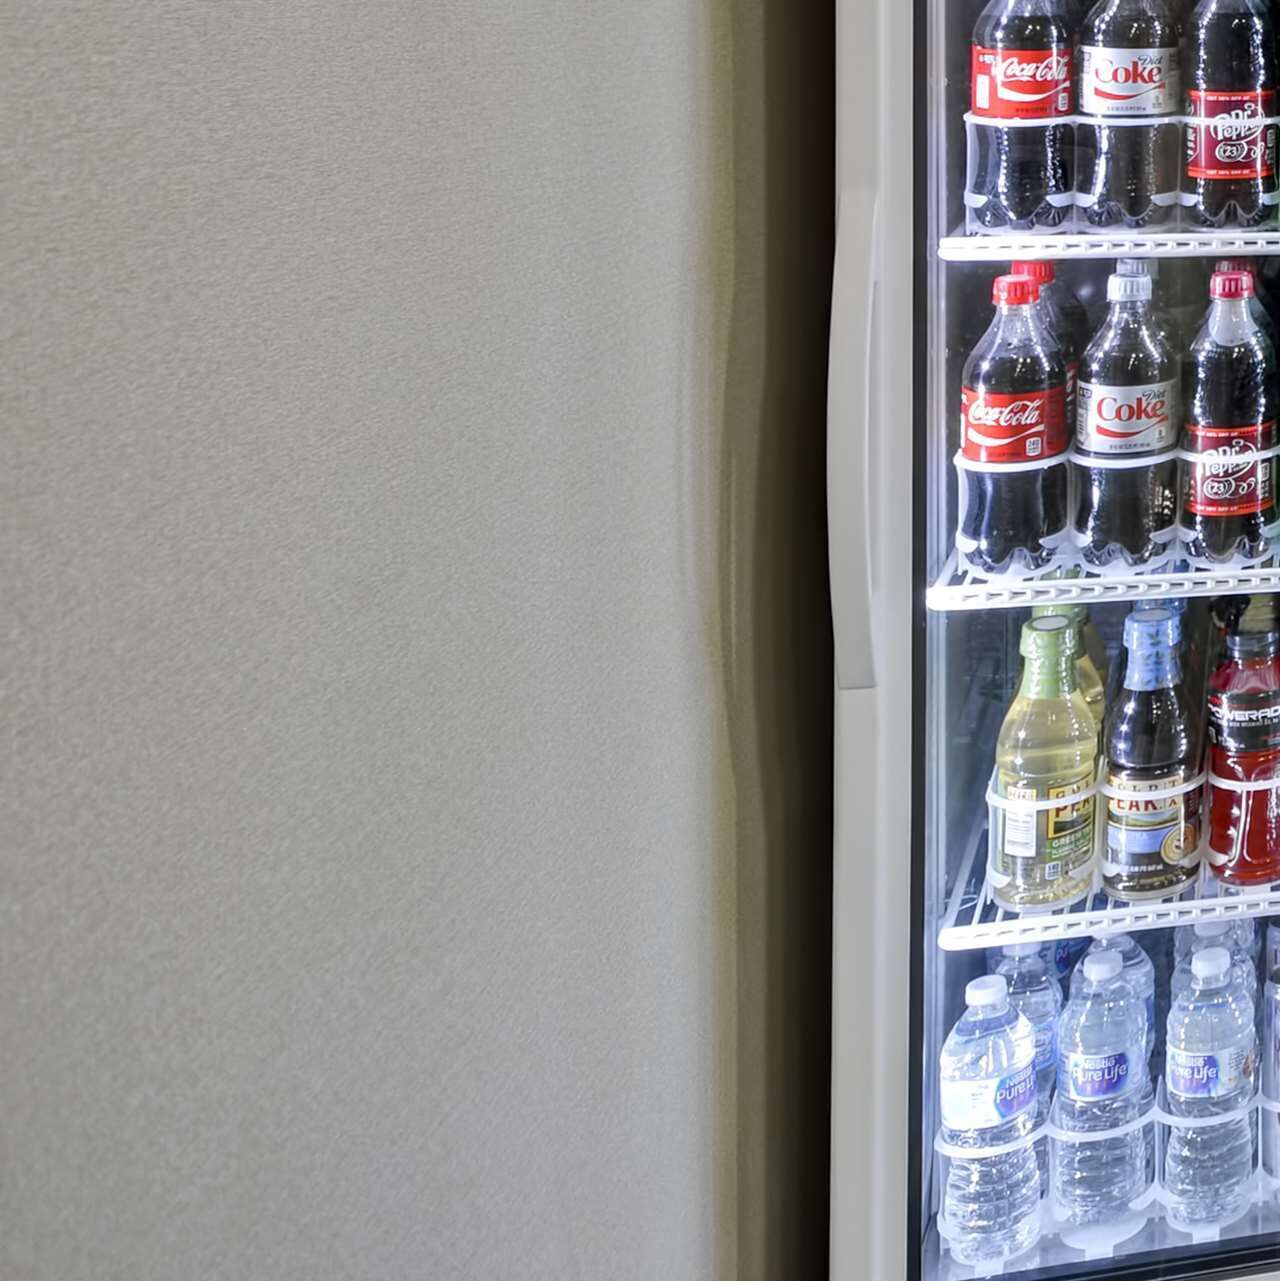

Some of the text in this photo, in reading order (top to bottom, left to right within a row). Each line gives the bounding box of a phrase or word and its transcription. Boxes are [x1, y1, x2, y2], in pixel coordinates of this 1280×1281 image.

[996, 55, 1069, 83] Coca-Cola
[1096, 60, 1162, 84] Coke
[1142, 389, 1167, 401] Diet
[968, 399, 1045, 426] Coca-Cola
[1097, 397, 1168, 421] Coke
[1103, 1063, 1128, 1084] Life
[1195, 1064, 1217, 1081] Life
